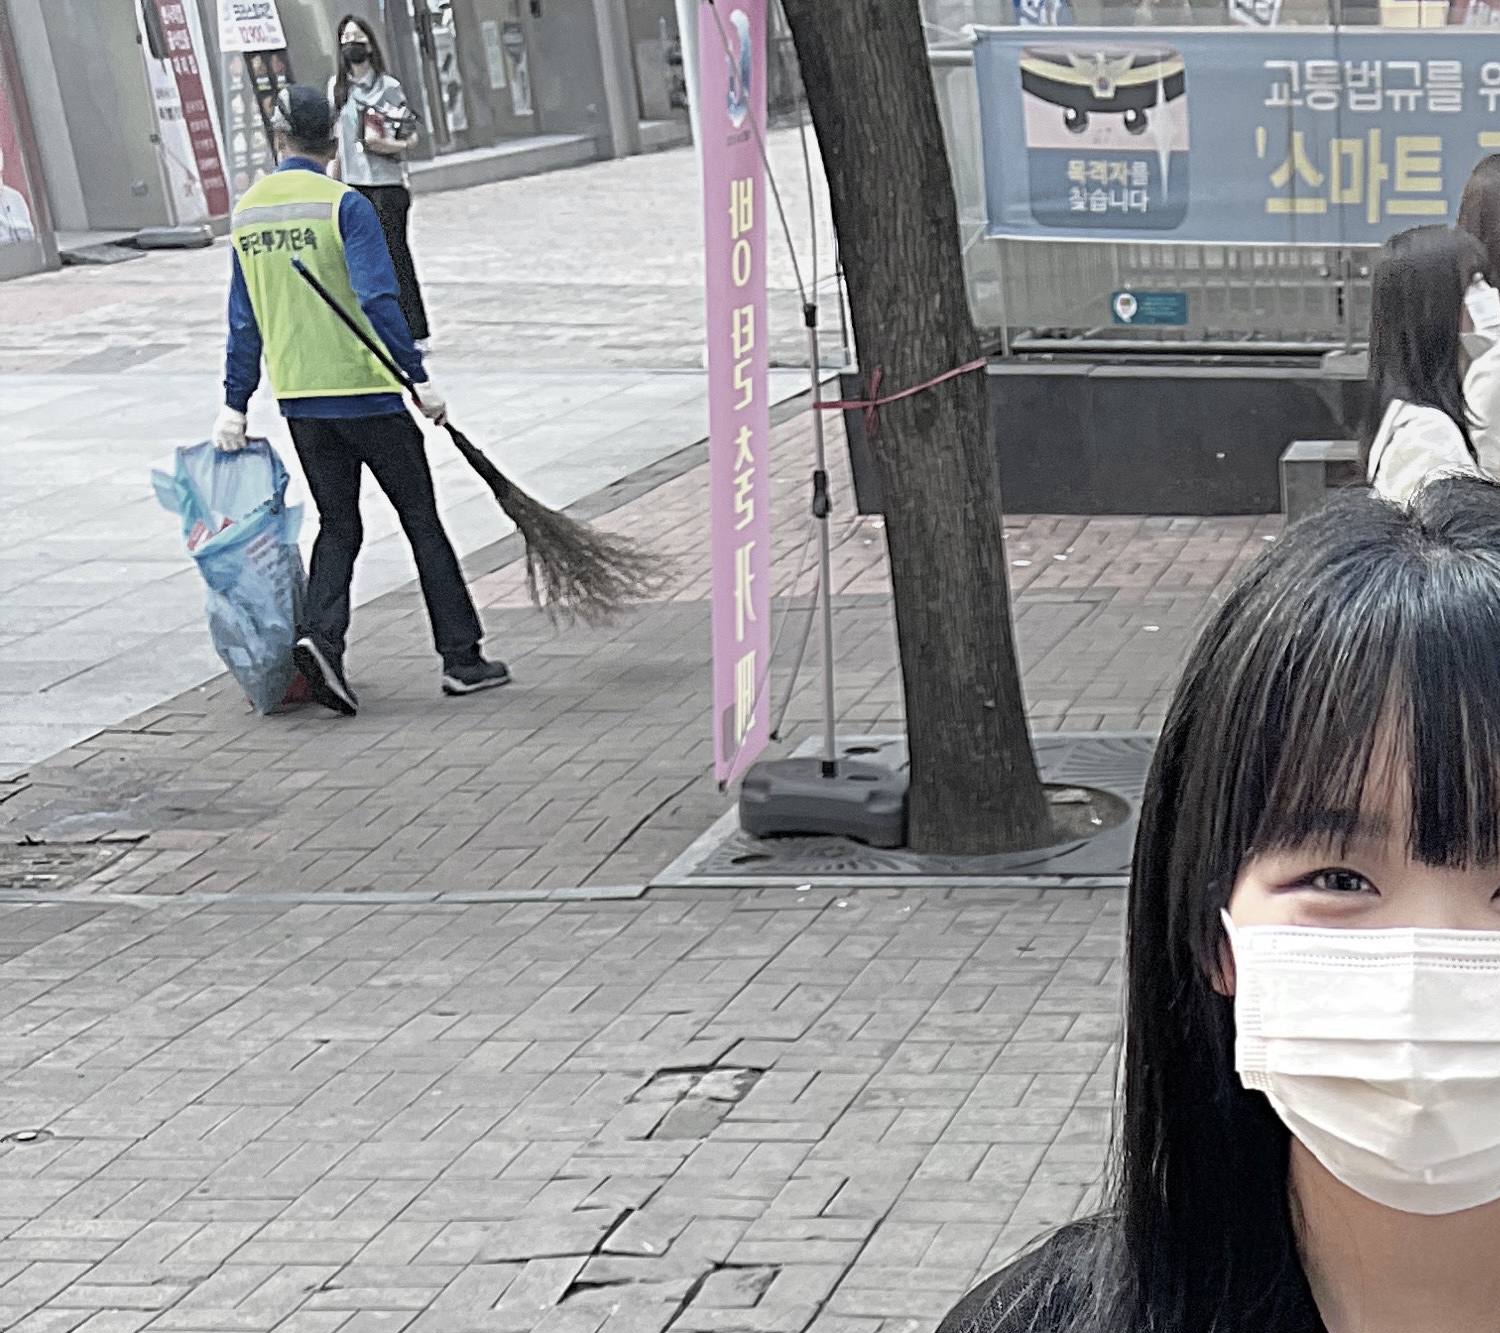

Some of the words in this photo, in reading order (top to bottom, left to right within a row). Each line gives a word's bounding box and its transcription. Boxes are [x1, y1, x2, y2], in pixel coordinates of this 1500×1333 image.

[1264, 59, 1464, 112] 교통법규를
[1067, 160, 1150, 187] 목격자를
[1256, 126, 1448, 224] '스마트
[1068, 186, 1150, 213] 찾습니다
